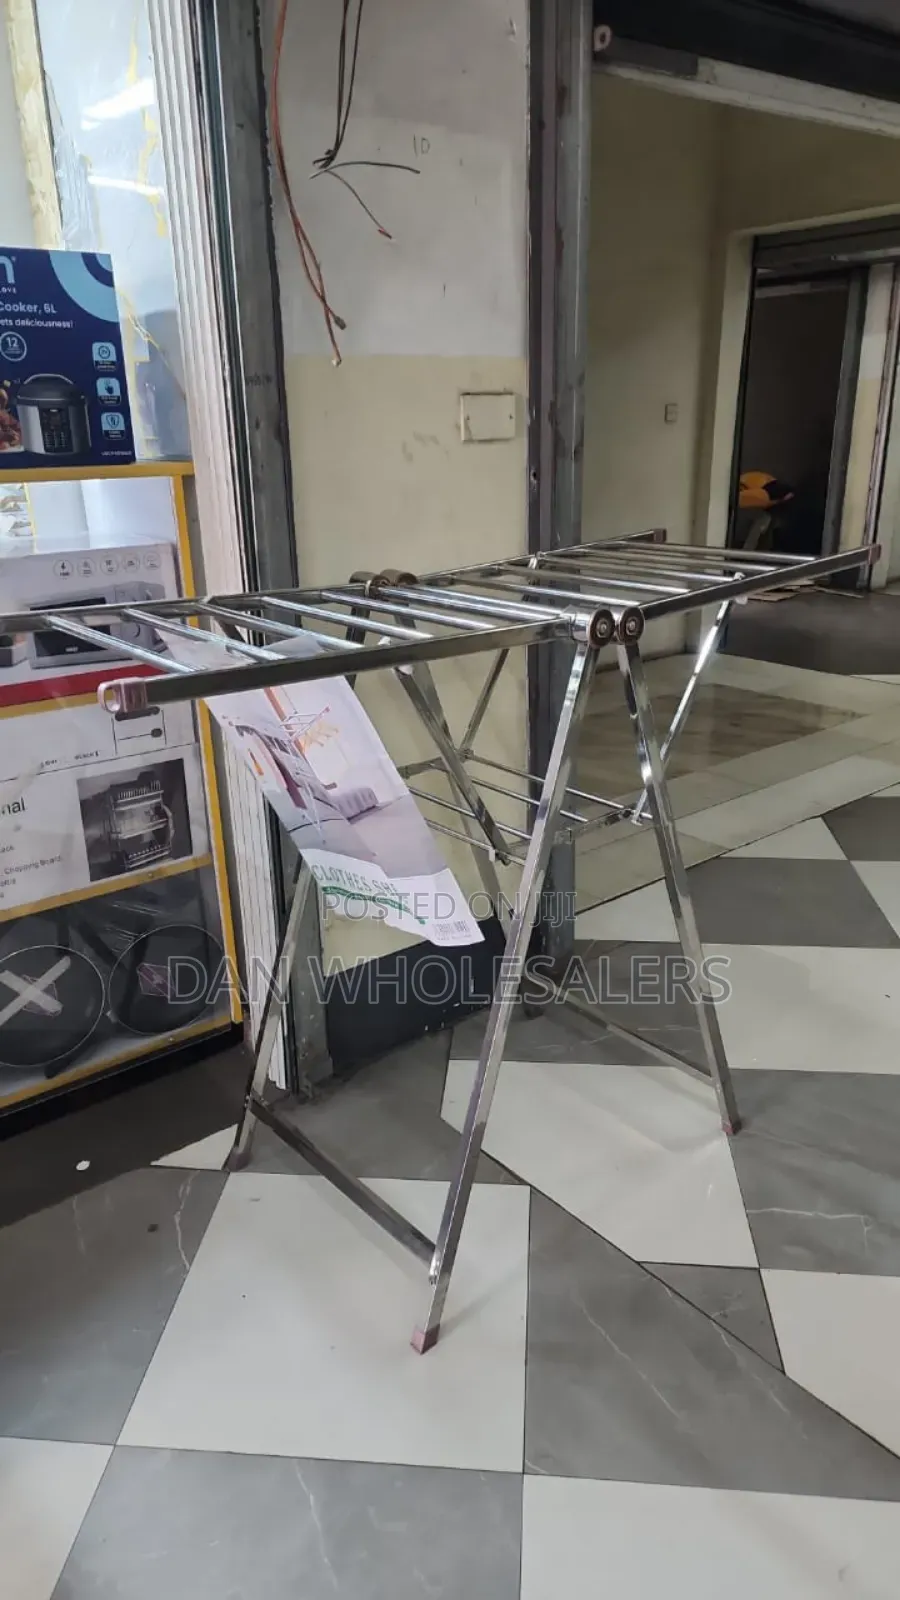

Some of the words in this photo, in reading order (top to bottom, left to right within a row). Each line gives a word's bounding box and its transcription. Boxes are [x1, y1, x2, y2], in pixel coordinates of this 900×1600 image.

[43, 303, 58, 314] 6L
[6, 337, 19, 348] 12
[311, 864, 372, 892] CLOTHES
